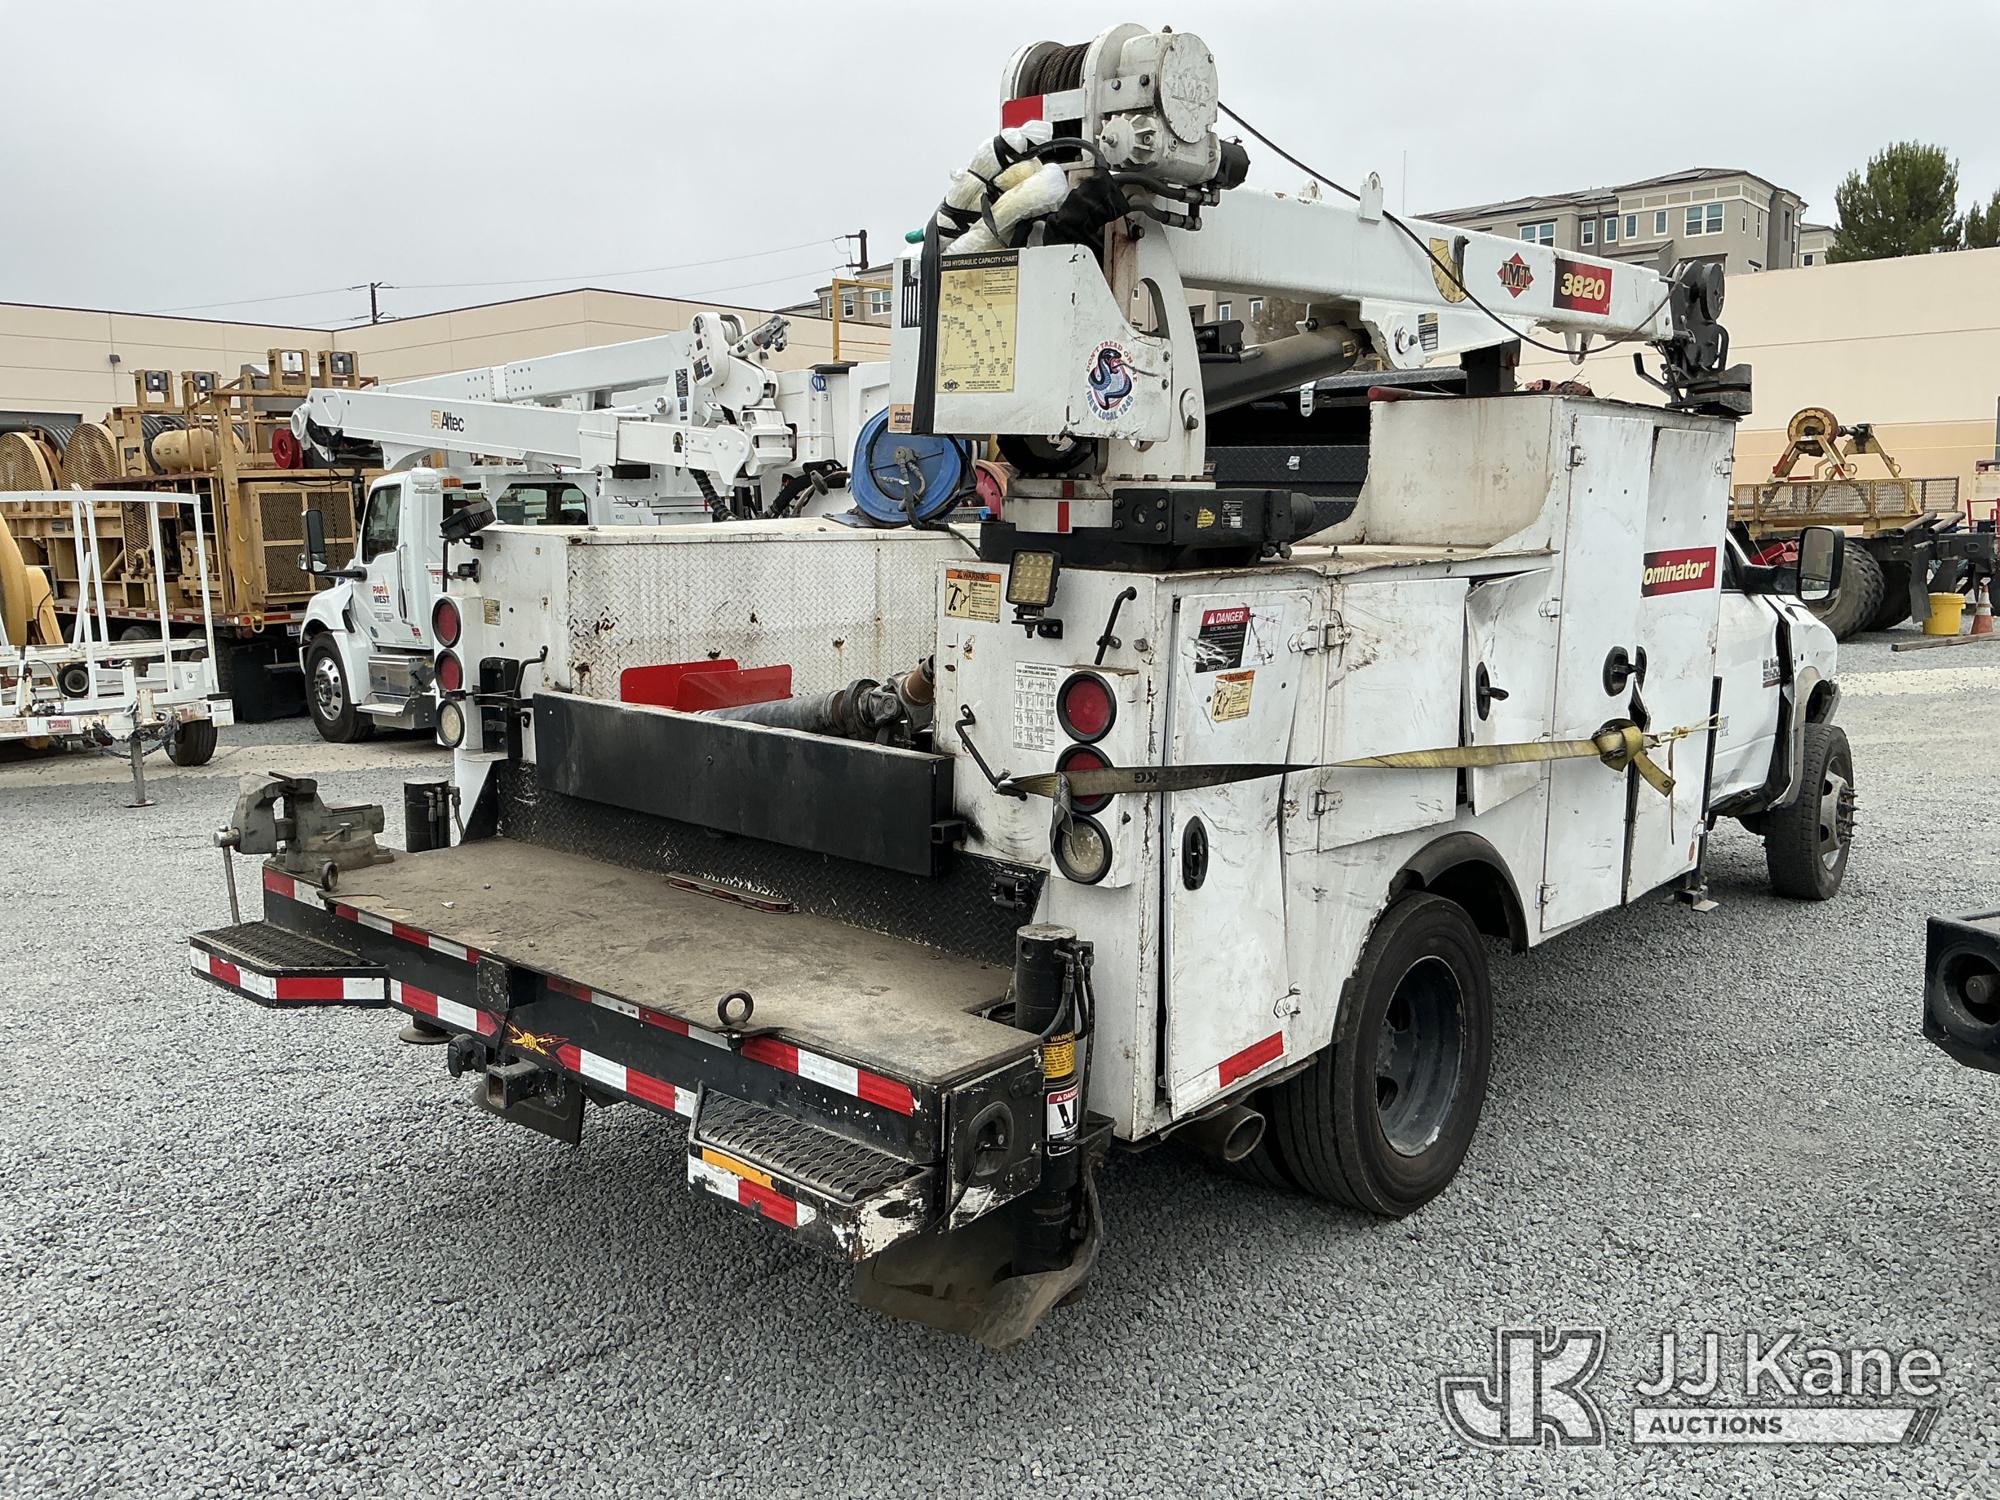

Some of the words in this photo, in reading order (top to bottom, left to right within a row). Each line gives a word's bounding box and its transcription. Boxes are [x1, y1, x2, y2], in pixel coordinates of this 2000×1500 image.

[951, 258, 978, 266] HYDRAULIC
[978, 256, 1001, 265] CAPACITY
[1001, 255, 1018, 263] CHART
[1501, 260, 1531, 290] IMT
[1560, 272, 1606, 301] 3820
[1100, 341, 1123, 352] TREAD
[1123, 351, 1134, 364] ON
[223, 408, 228, 417] 1
[1098, 410, 1119, 421] LOCAL
[1119, 395, 1134, 415] 1245
[129, 416, 135, 424] 1
[441, 411, 465, 432] Altec
[963, 571, 990, 581] WARNING
[1642, 558, 1707, 586] ominator
[372, 586, 385, 595] PAR
[374, 595, 390, 604] WEST
[1216, 610, 1244, 624] DANGER
[1134, 772, 1158, 783] KG
